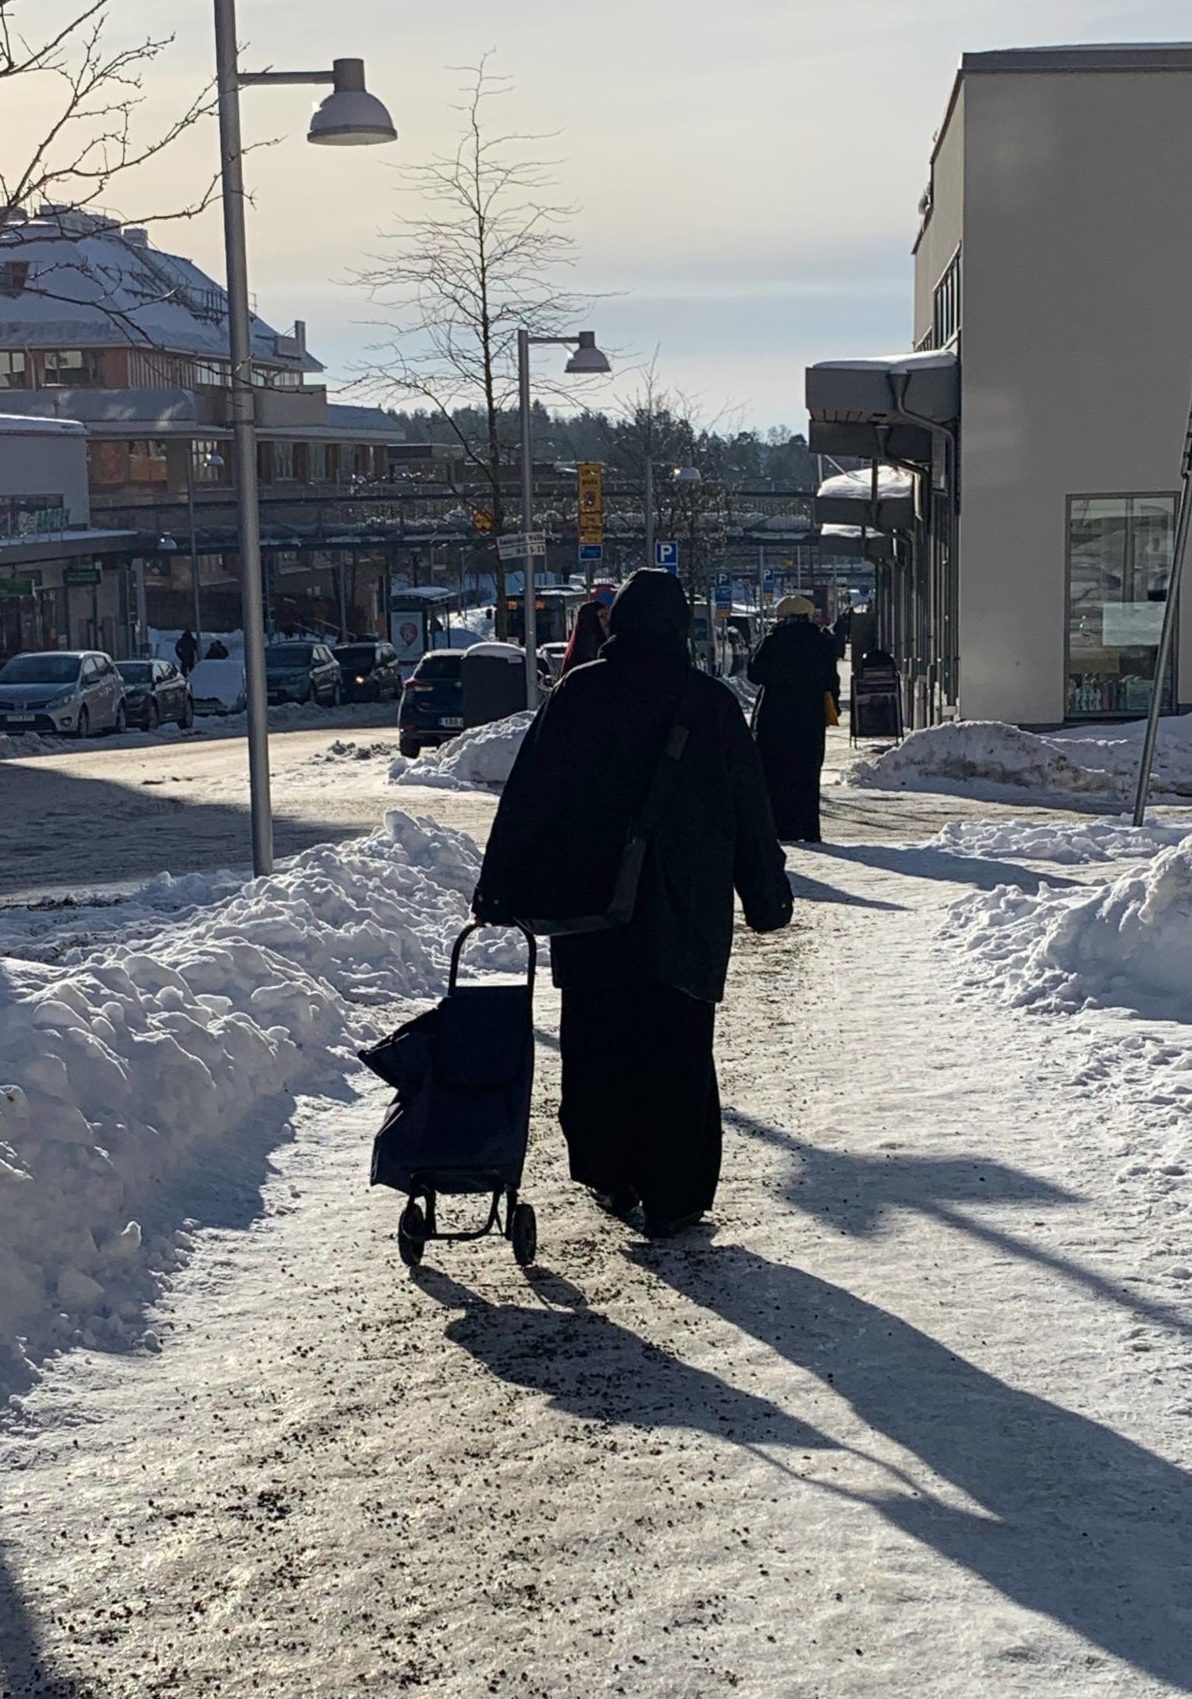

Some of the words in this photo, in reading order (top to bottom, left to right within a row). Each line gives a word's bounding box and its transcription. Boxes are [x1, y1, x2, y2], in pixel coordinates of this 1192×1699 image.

[660, 544, 673, 562] P
[719, 574, 728, 584] P
[763, 569, 771, 580] P
